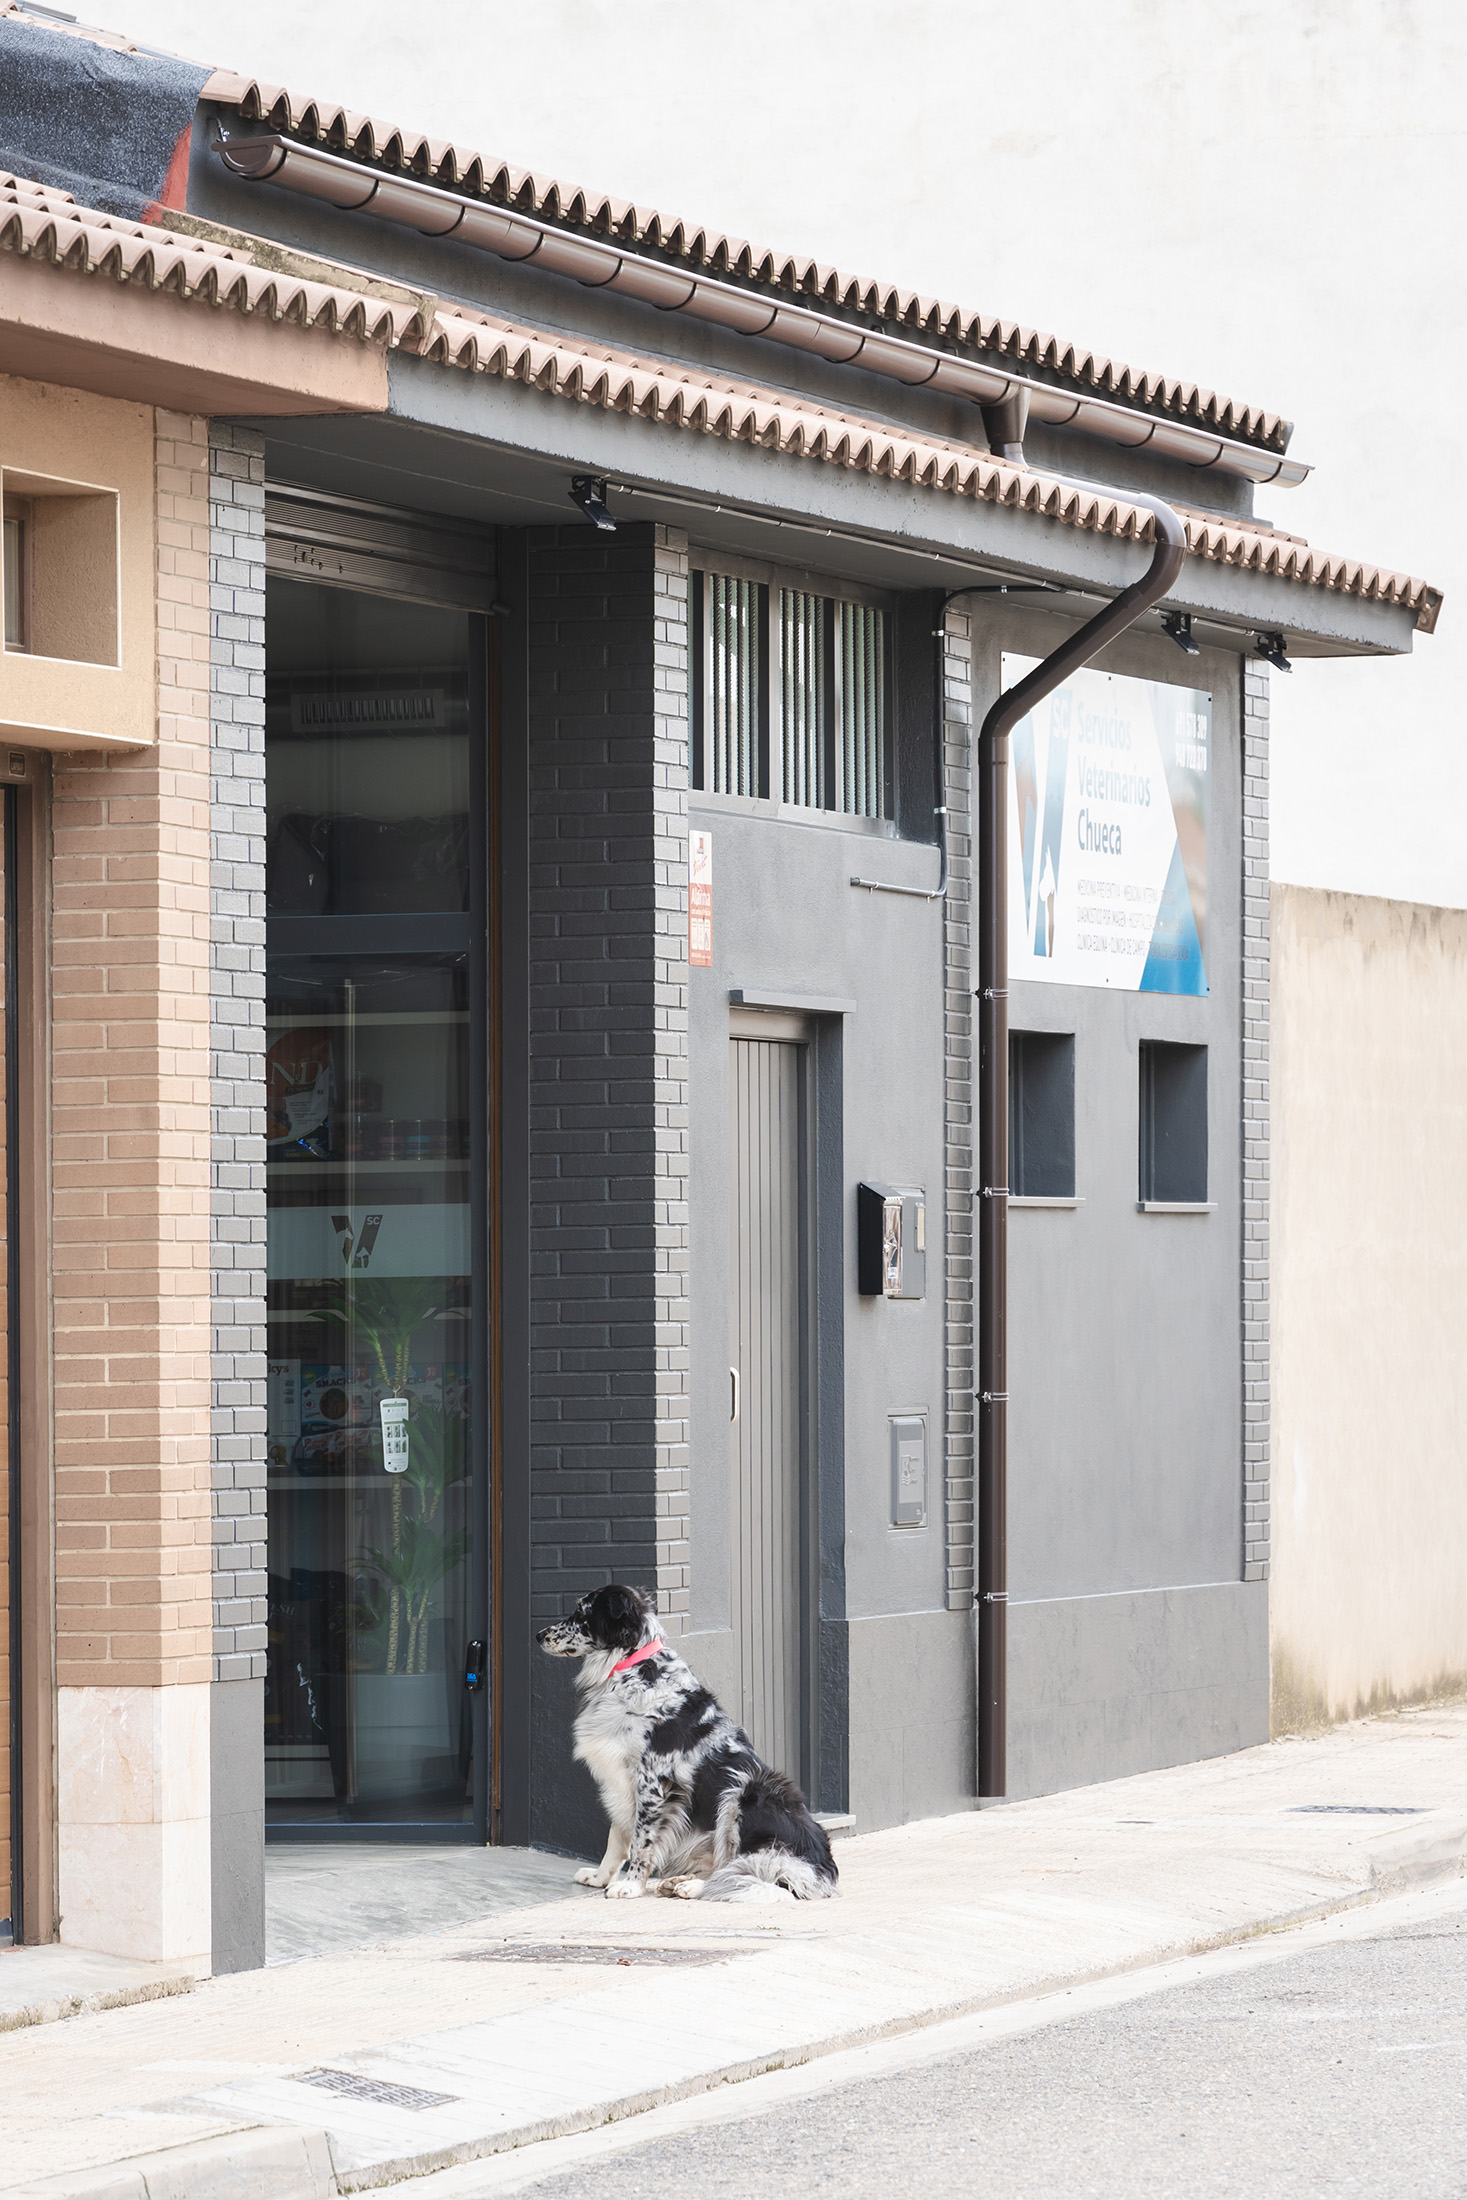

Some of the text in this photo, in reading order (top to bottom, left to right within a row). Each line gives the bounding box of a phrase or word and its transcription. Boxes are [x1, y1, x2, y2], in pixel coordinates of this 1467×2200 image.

[1052, 696, 1069, 739] SC
[1078, 701, 1132, 751] Servicios
[1078, 754, 1151, 807] Veterinarios
[1078, 808, 1123, 855] Chueca
[691, 887, 711, 906] Alarma
[366, 1216, 380, 1226] SC
